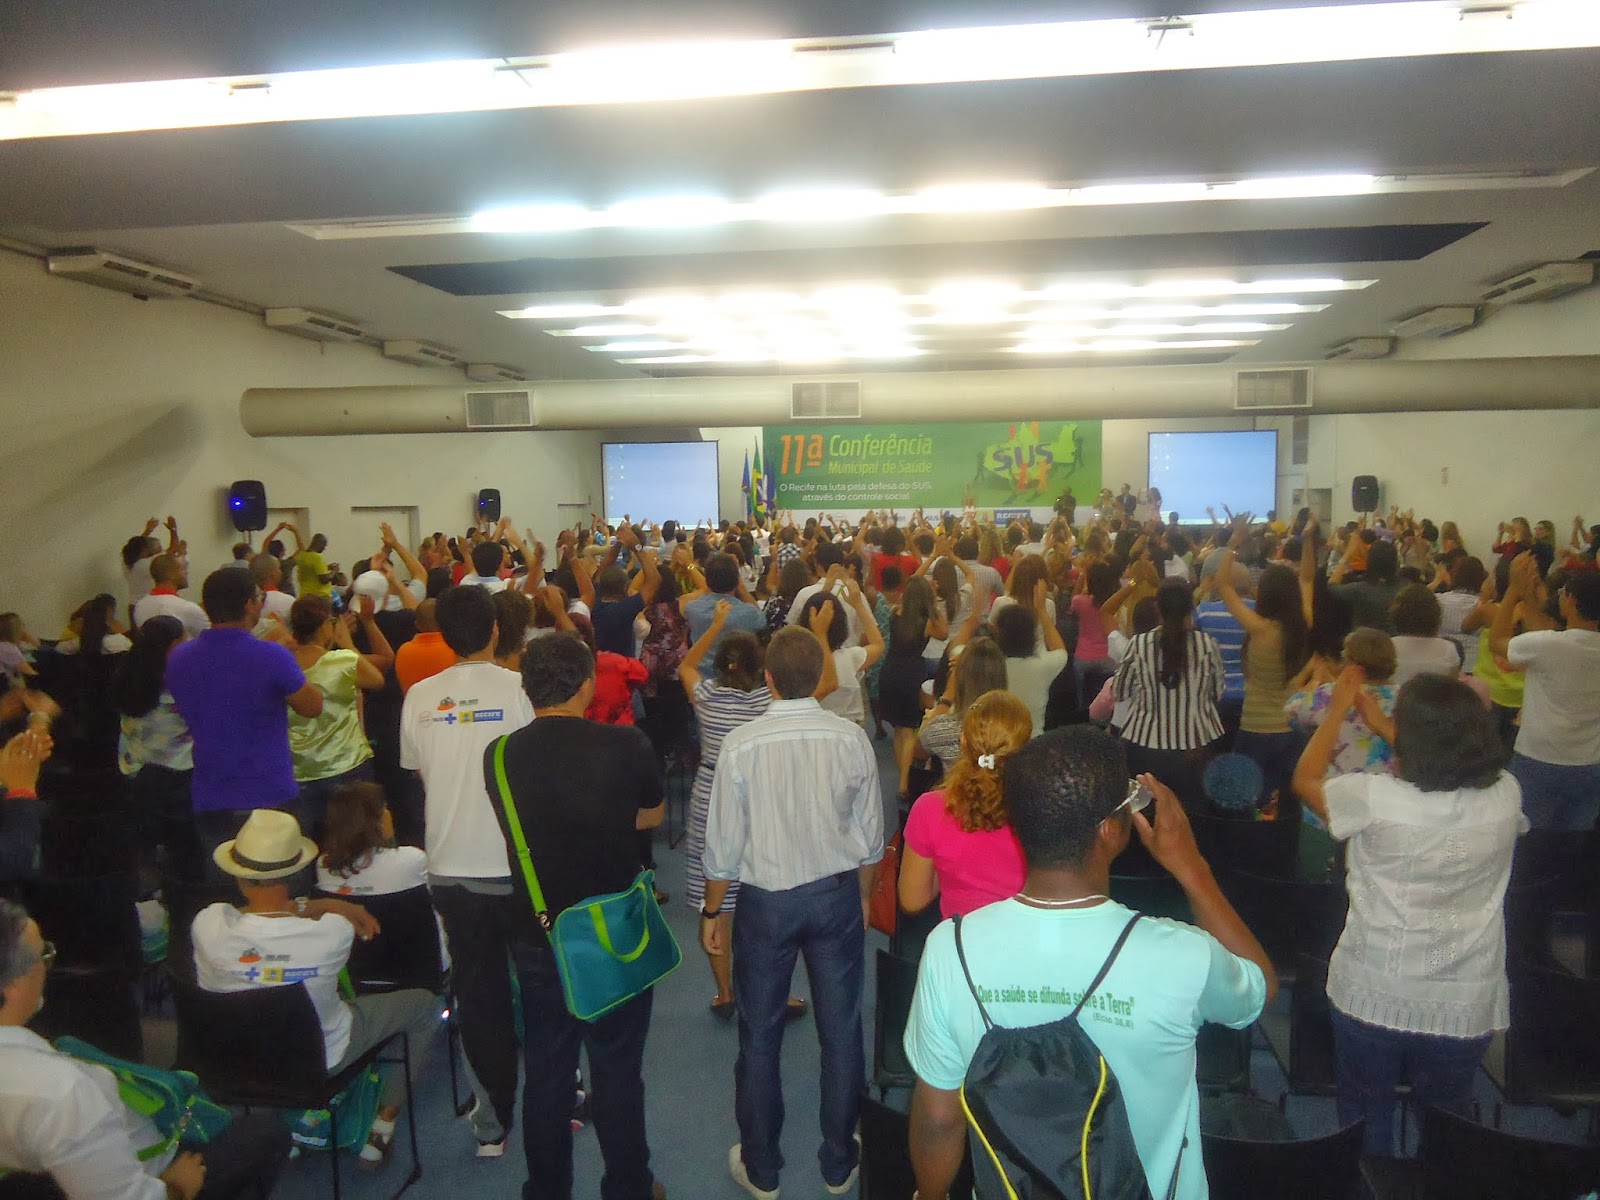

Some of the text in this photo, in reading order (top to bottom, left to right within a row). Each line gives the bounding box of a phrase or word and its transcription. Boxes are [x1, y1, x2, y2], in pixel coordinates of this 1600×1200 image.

[829, 433, 933, 459] Conferência
[993, 442, 1053, 472] SUS
[828, 460, 933, 476] Municipal de Saúde
[780, 483, 788, 492] O
[789, 483, 816, 491] Recife
[829, 483, 846, 491] luta
[847, 482, 866, 492] pela
[867, 482, 898, 490] defesa
[898, 482, 911, 490] do
[802, 492, 910, 501] através do controle social
[994, 989, 1000, 1003] a
[1001, 984, 1026, 1003] saúde
[1027, 989, 1038, 1003] se
[1040, 985, 1072, 1005] difunda
[1099, 995, 1106, 1011] a
